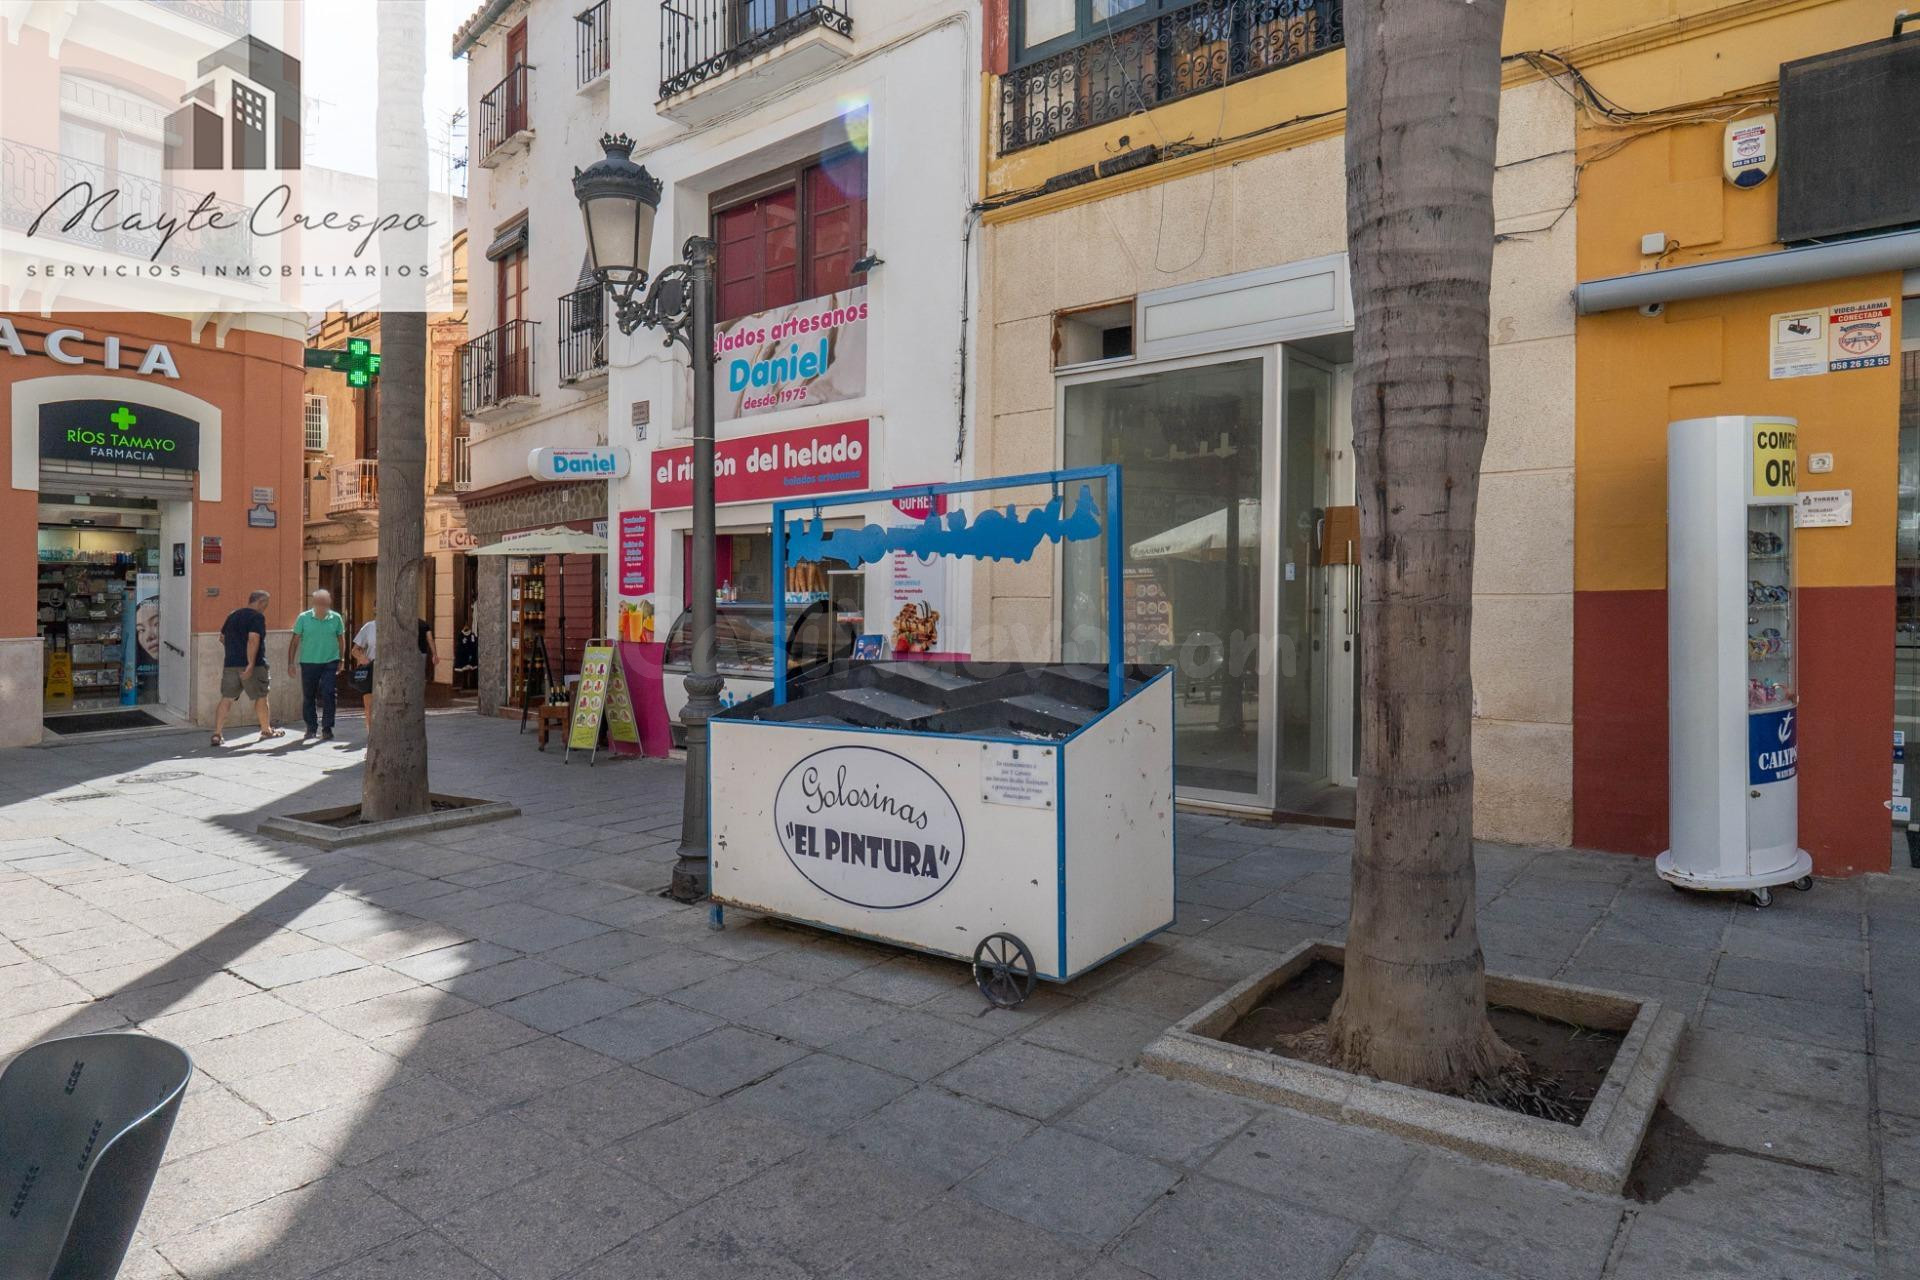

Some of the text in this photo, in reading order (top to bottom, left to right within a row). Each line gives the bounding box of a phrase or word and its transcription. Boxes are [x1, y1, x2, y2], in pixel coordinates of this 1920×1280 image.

[1834, 301, 1888, 314] VIDEO-ALARMA
[1838, 310, 1883, 322] CONECTADA
[771, 303, 867, 340] artesanos
[729, 337, 828, 393] Daniel
[1831, 356, 1889, 370] 958 26 52 55
[744, 387, 806, 410] desde 1975
[67, 427, 176, 451] RÍOS TAMAYO
[638, 425, 644, 438] 7
[1757, 431, 1797, 450] COMPR
[90, 446, 155, 462] FARMACIA
[553, 453, 616, 474] Daniel
[656, 434, 863, 484] el rión del helado
[801, 764, 928, 830] Golosinas
